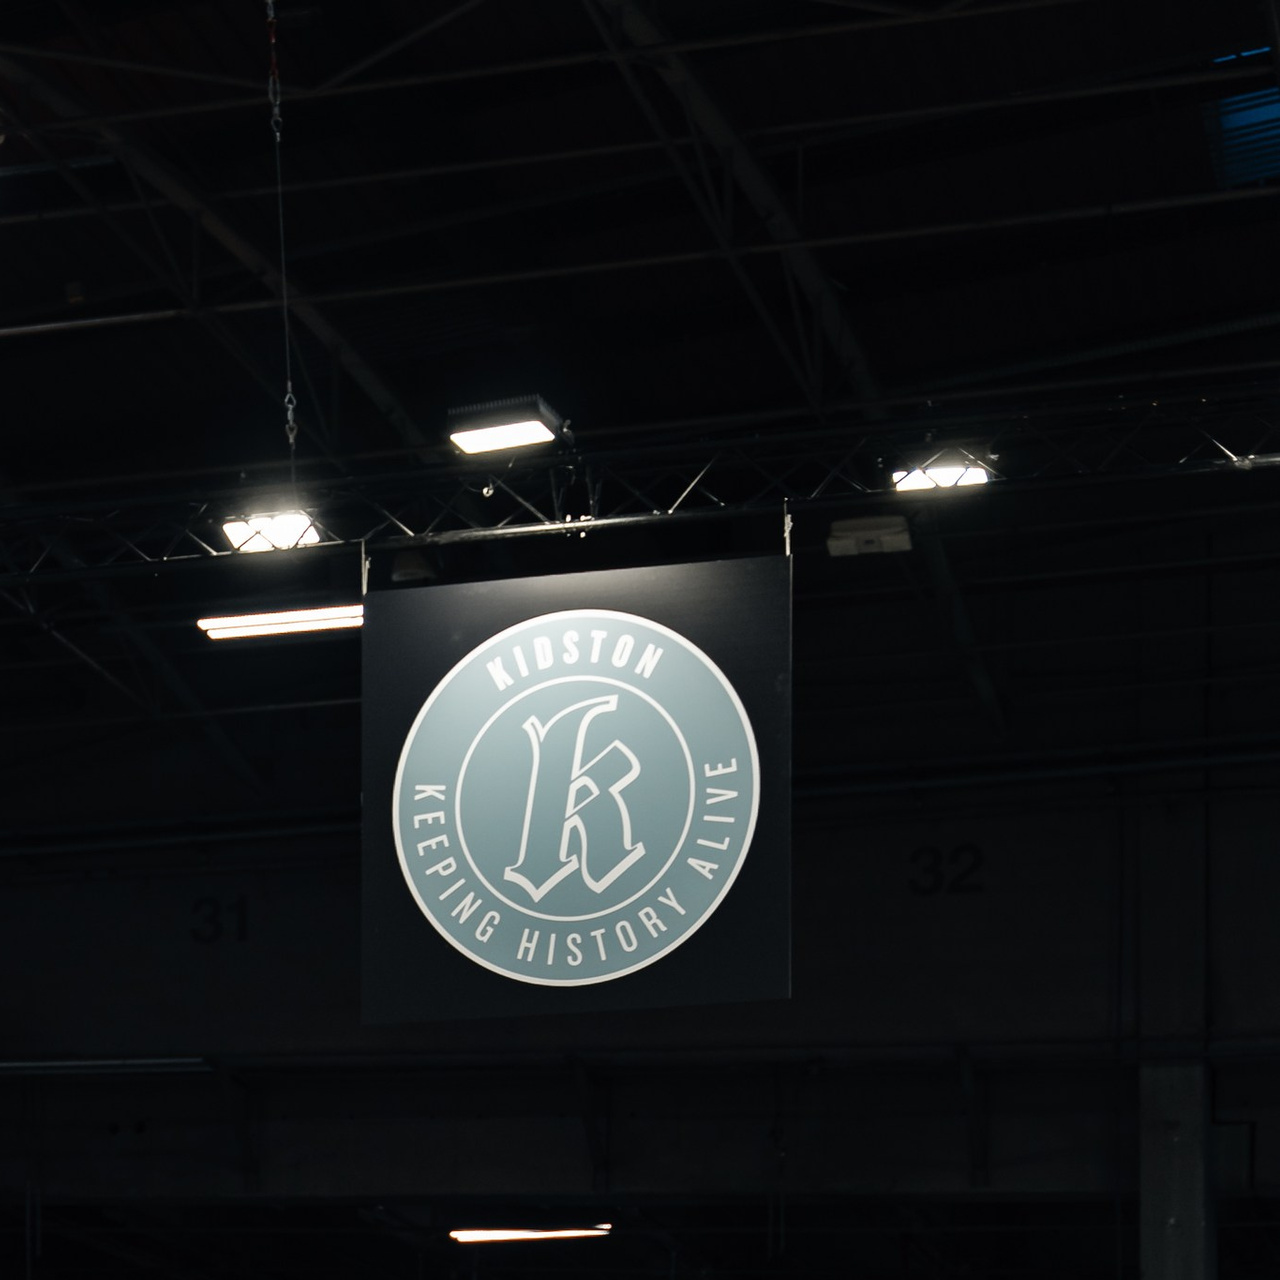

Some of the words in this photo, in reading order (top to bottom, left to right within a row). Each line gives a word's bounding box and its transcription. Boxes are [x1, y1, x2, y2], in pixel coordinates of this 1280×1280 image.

[486, 630, 664, 691] KIDSTON
[414, 783, 501, 944] KEEPING
[516, 887, 687, 967] HISTORY
[686, 757, 739, 881] ALIVE
[909, 844, 986, 895] 32
[190, 895, 250, 944] 31
